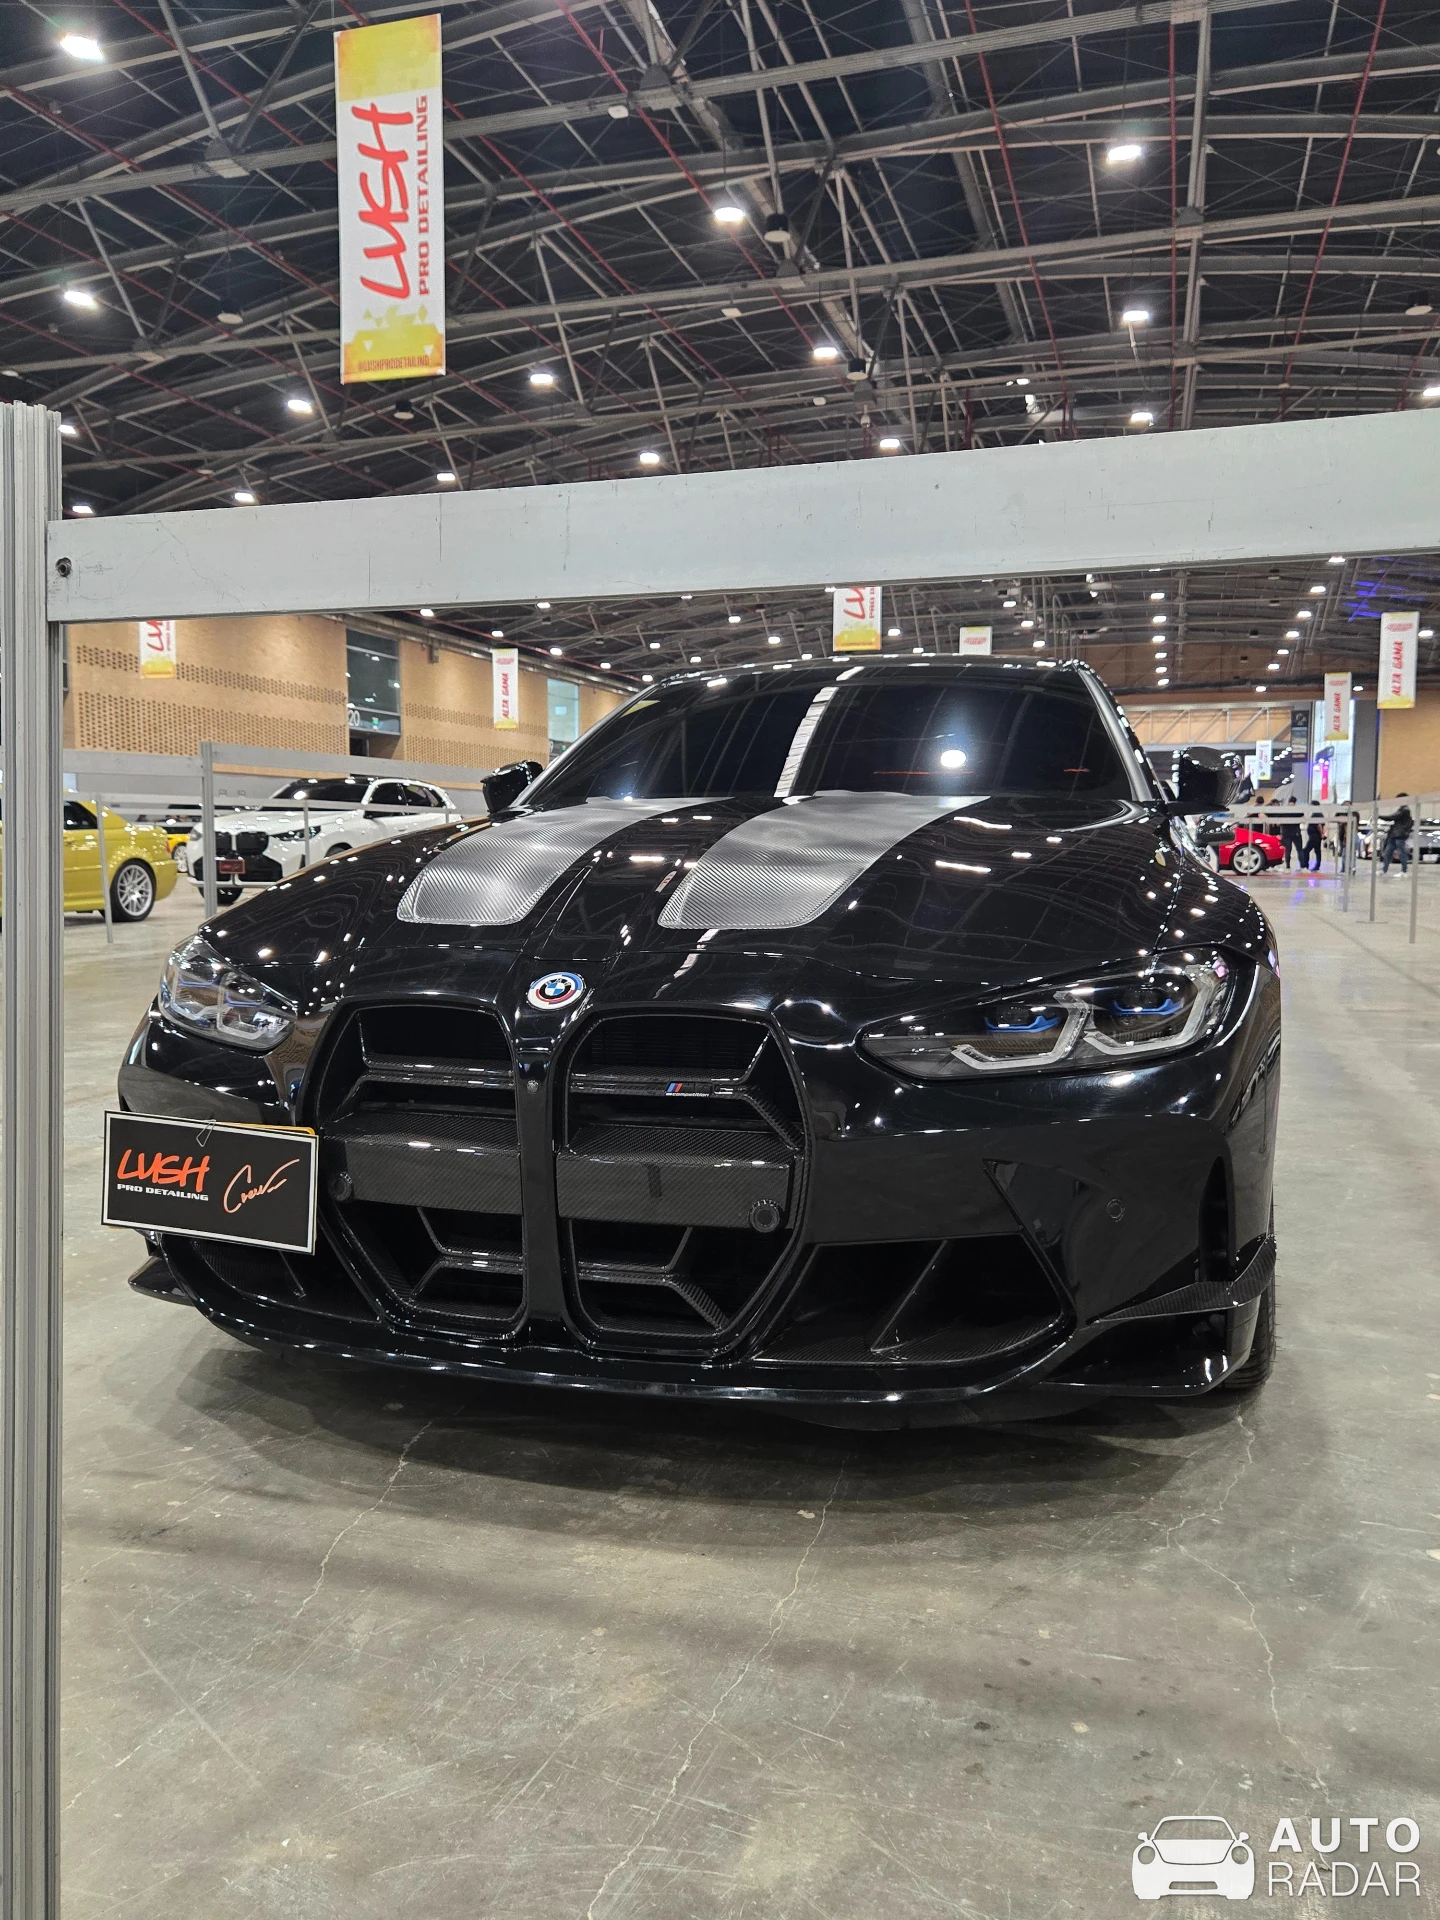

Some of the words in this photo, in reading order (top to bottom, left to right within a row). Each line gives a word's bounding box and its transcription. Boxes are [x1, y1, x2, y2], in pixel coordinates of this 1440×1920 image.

[416, 95, 429, 233] DETAILING
[351, 102, 414, 299] LUSH
[417, 241, 430, 295] PRO
[117, 1149, 210, 1192] LUSH
[117, 1183, 143, 1193] PRO
[145, 1186, 209, 1202] DETAILING
